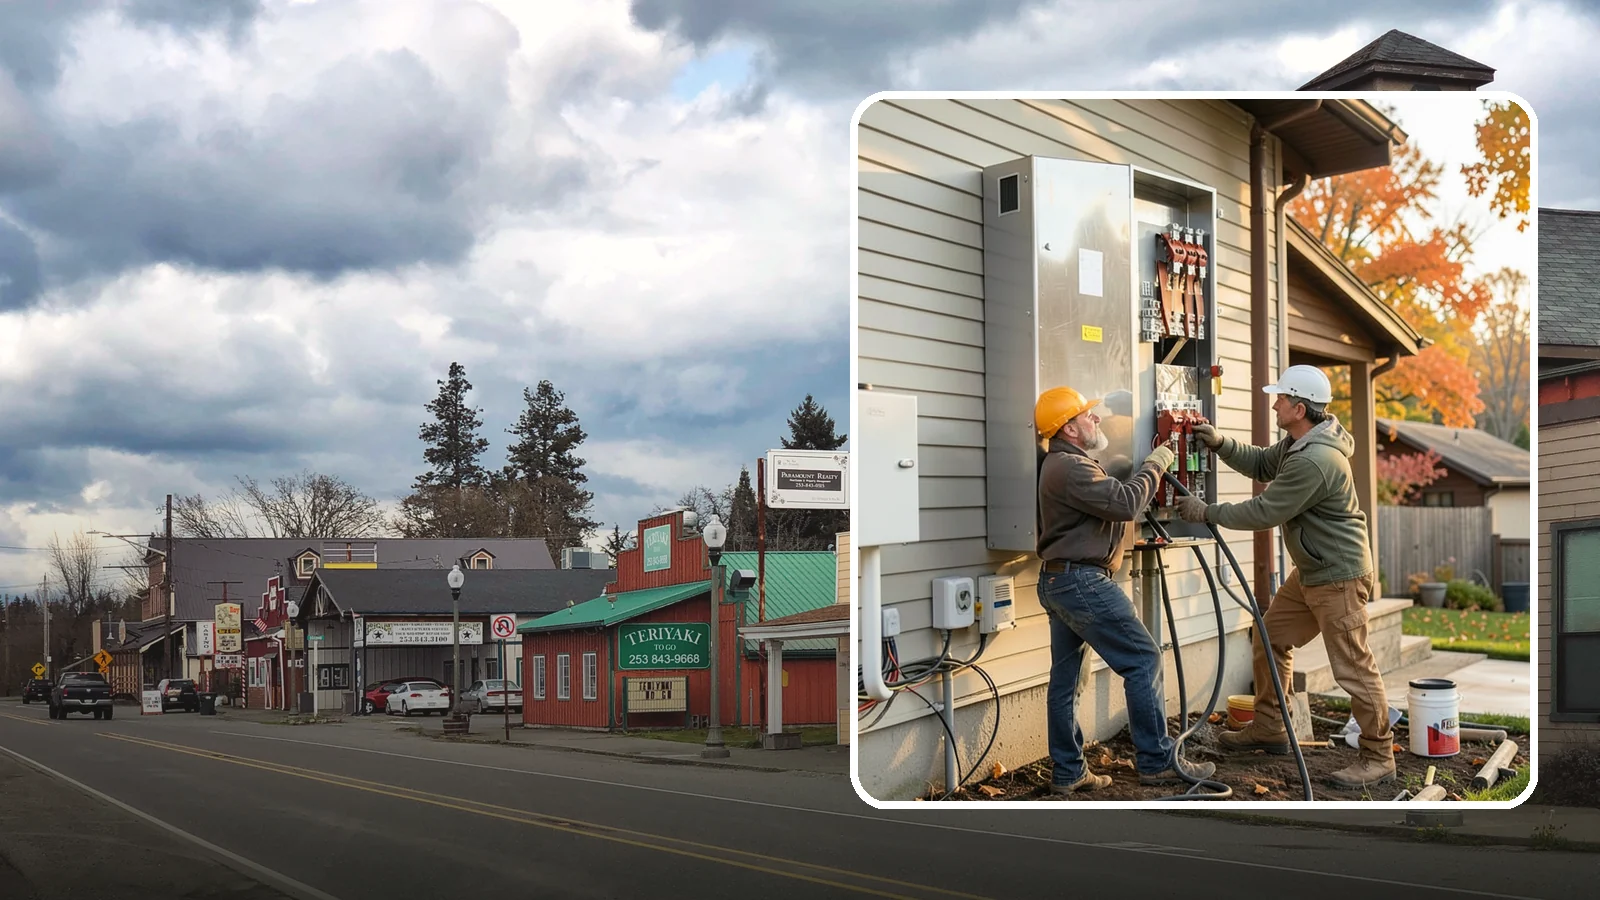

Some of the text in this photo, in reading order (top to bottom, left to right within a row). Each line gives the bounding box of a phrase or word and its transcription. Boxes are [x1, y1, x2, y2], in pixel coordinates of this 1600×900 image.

[781, 471, 815, 479] PARAMOUNT
[625, 627, 702, 646] TERIYAKI
[629, 654, 700, 664] 253 843-9668
